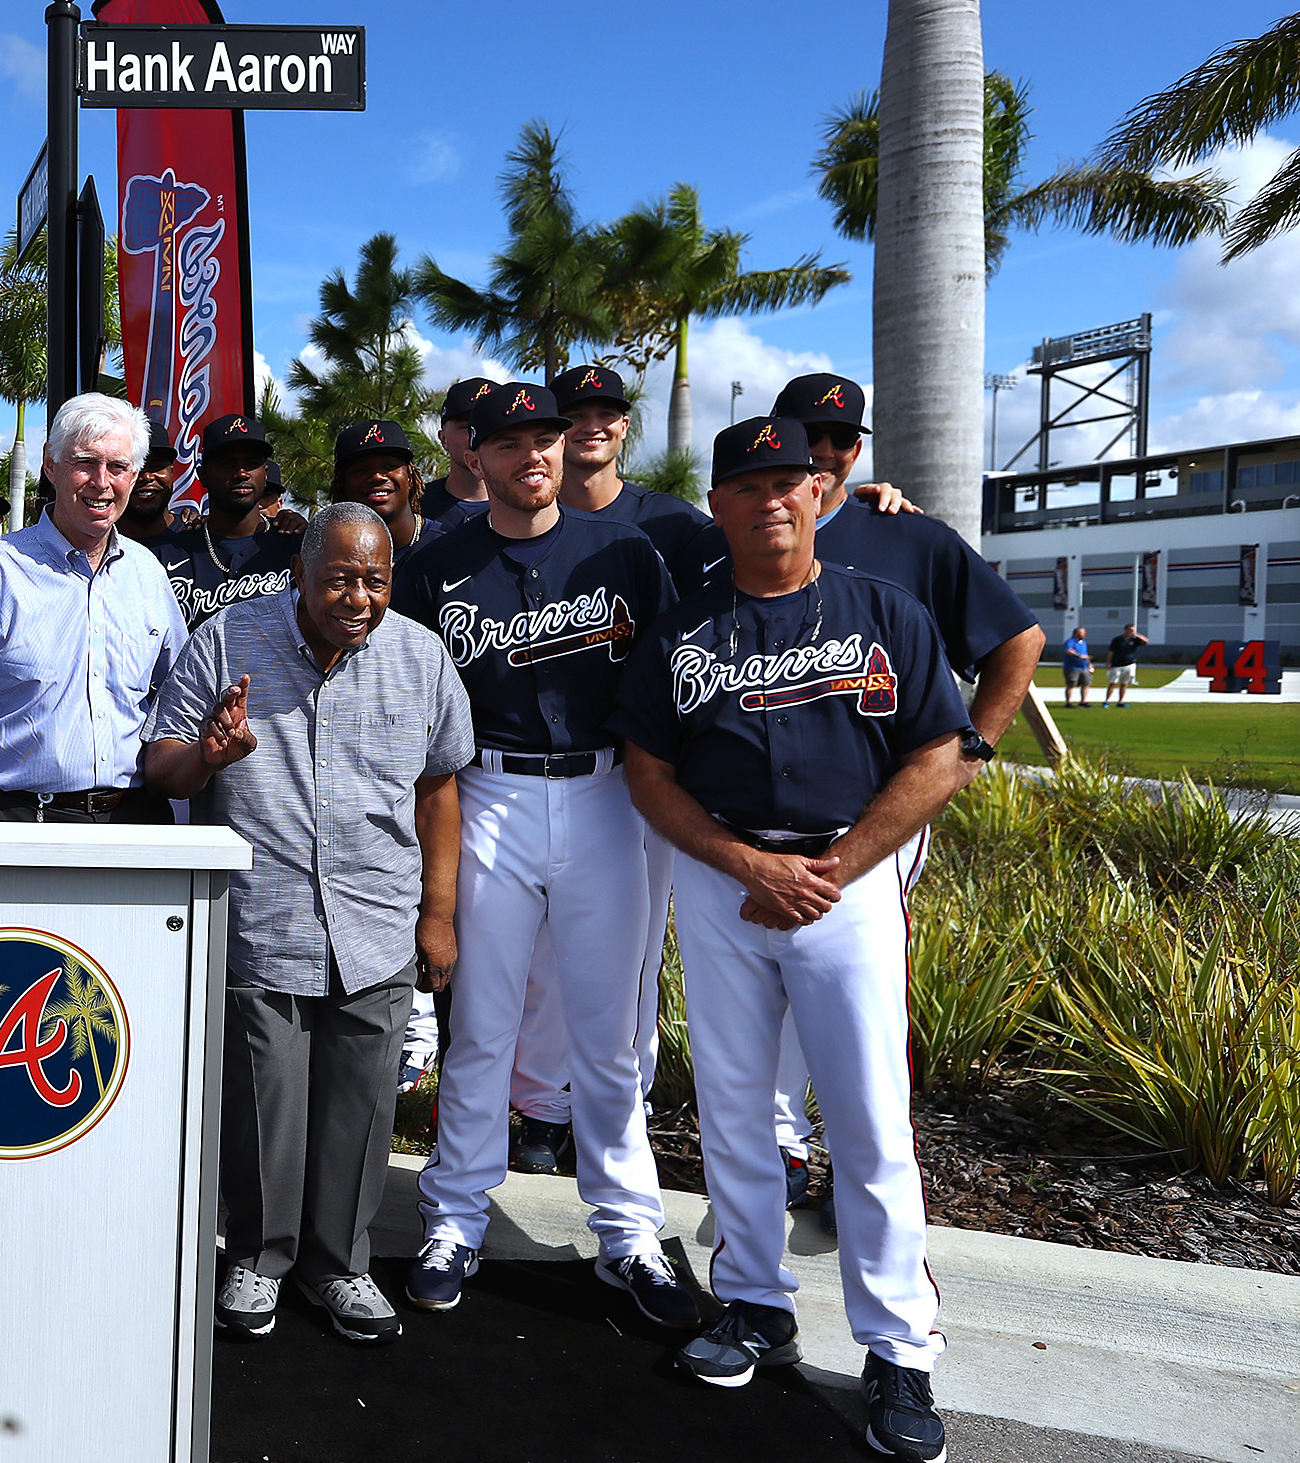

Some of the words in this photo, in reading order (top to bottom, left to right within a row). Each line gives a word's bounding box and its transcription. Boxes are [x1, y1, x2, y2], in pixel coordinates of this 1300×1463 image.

[86, 41, 195, 93] Hank
[204, 41, 332, 93] Aaron
[321, 34, 356, 54] WAY
[437, 586, 609, 668] Braves
[670, 634, 863, 722] Braves
[1196, 640, 1267, 693] 44
